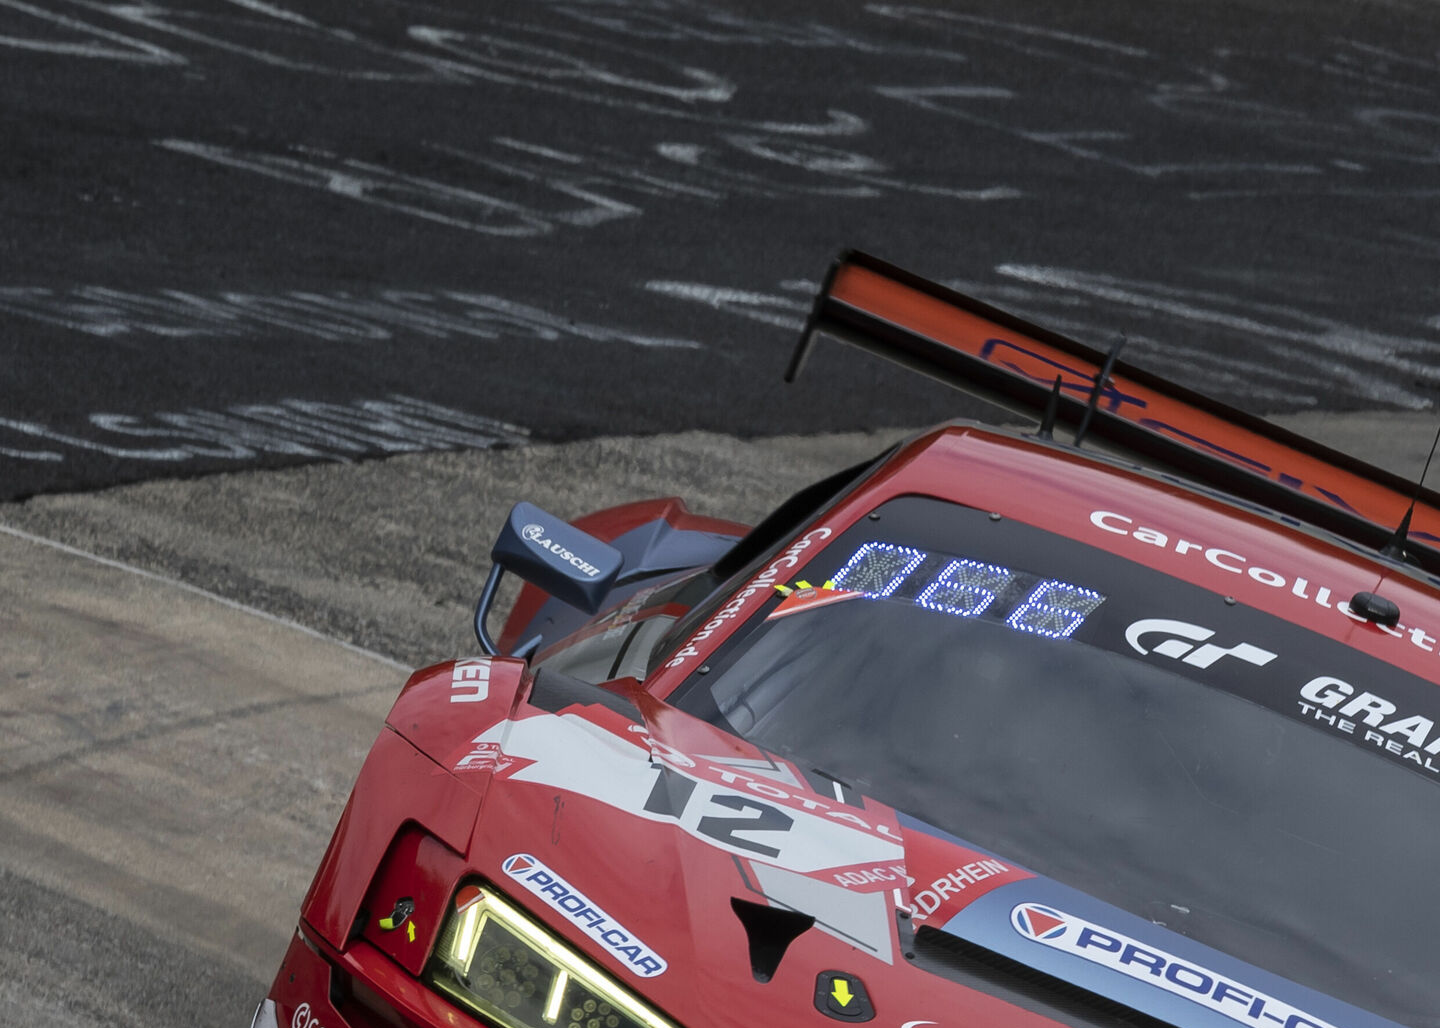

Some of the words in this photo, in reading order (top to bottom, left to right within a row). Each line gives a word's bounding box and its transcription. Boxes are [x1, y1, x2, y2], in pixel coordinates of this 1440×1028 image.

[665, 527, 832, 668] CarCollection.de
[1298, 701, 1357, 736] THE
[1364, 729, 1439, 773] REAL
[642, 762, 795, 859] 12
[708, 766, 904, 842] TOTAL
[526, 868, 663, 978] PROFI-CAR
[833, 866, 897, 888] ADAC
[892, 858, 1009, 931] NRDRHEIN
